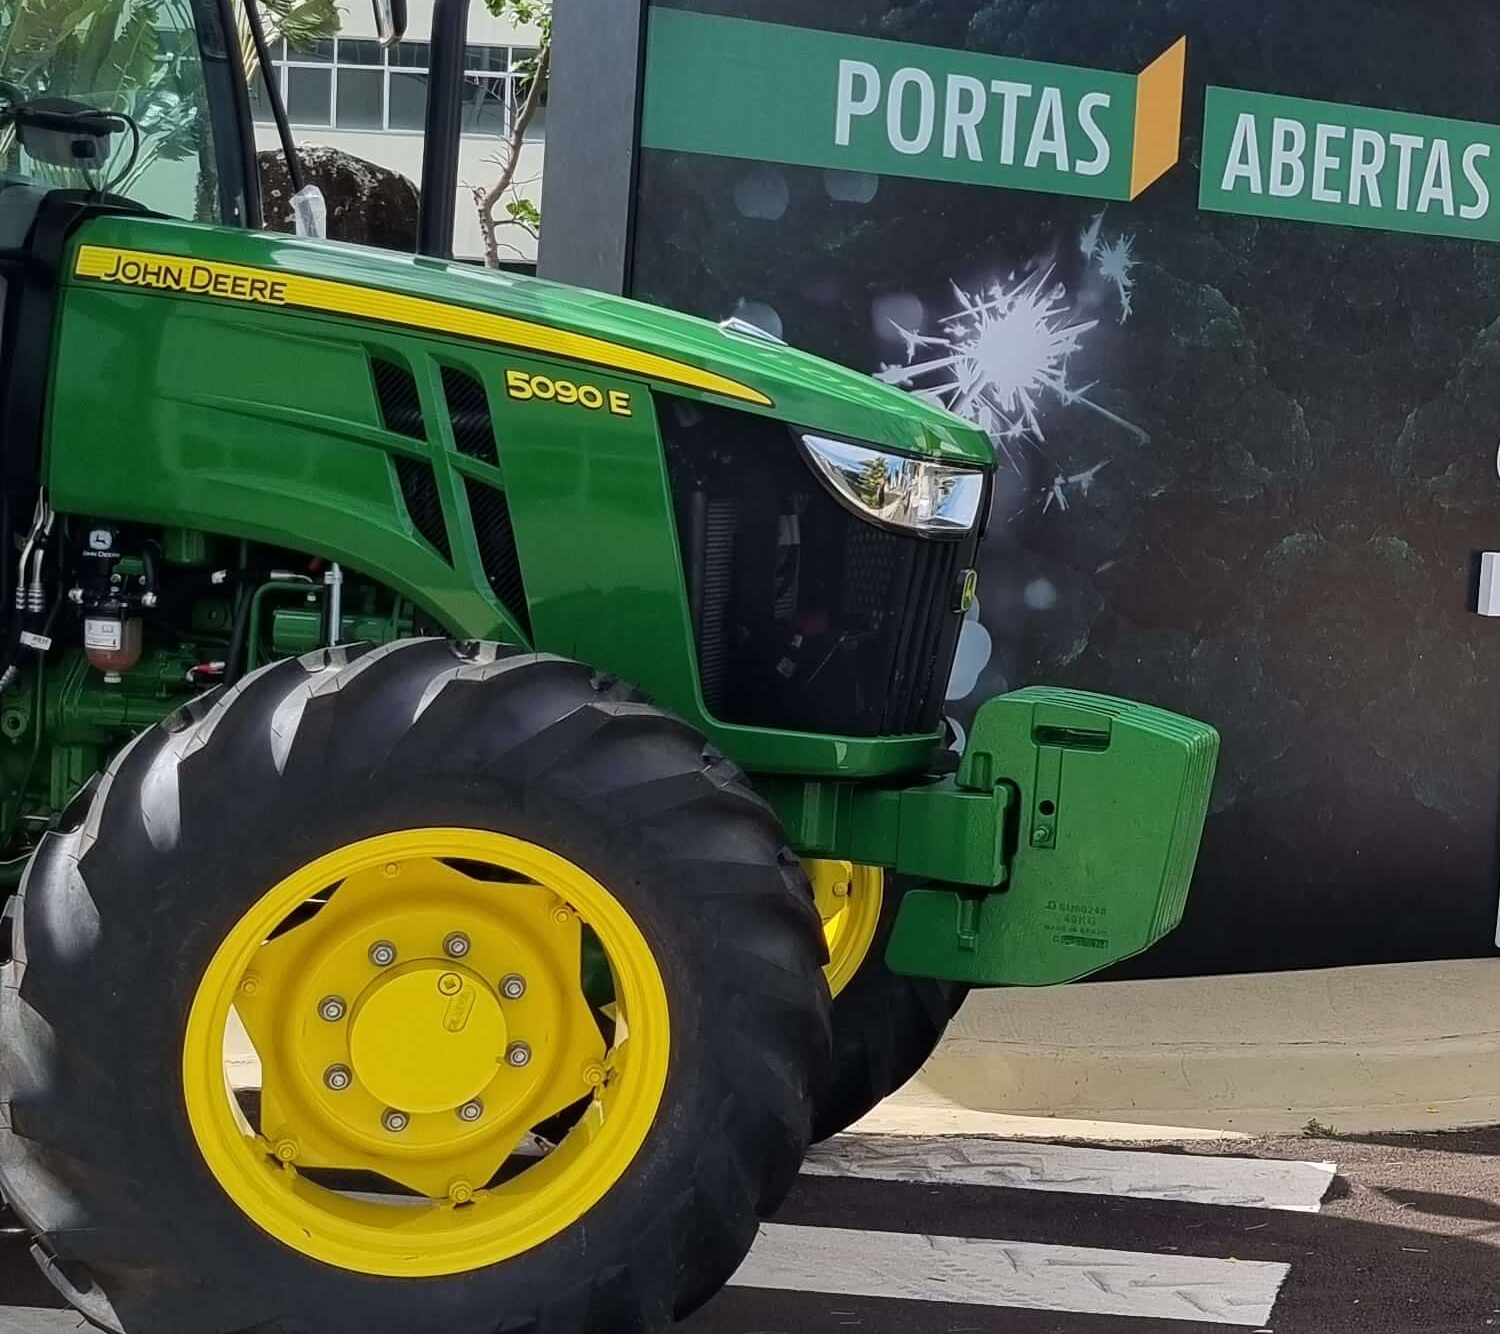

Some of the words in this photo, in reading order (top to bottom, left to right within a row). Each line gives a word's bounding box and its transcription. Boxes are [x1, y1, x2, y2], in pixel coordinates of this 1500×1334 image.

[835, 58, 1111, 176] PORTAS
[1221, 112, 1492, 220] ABERTAS
[104, 255, 183, 287] JOHN
[189, 265, 287, 302] DEERE
[506, 369, 604, 409] 5090
[608, 389, 632, 417] E
